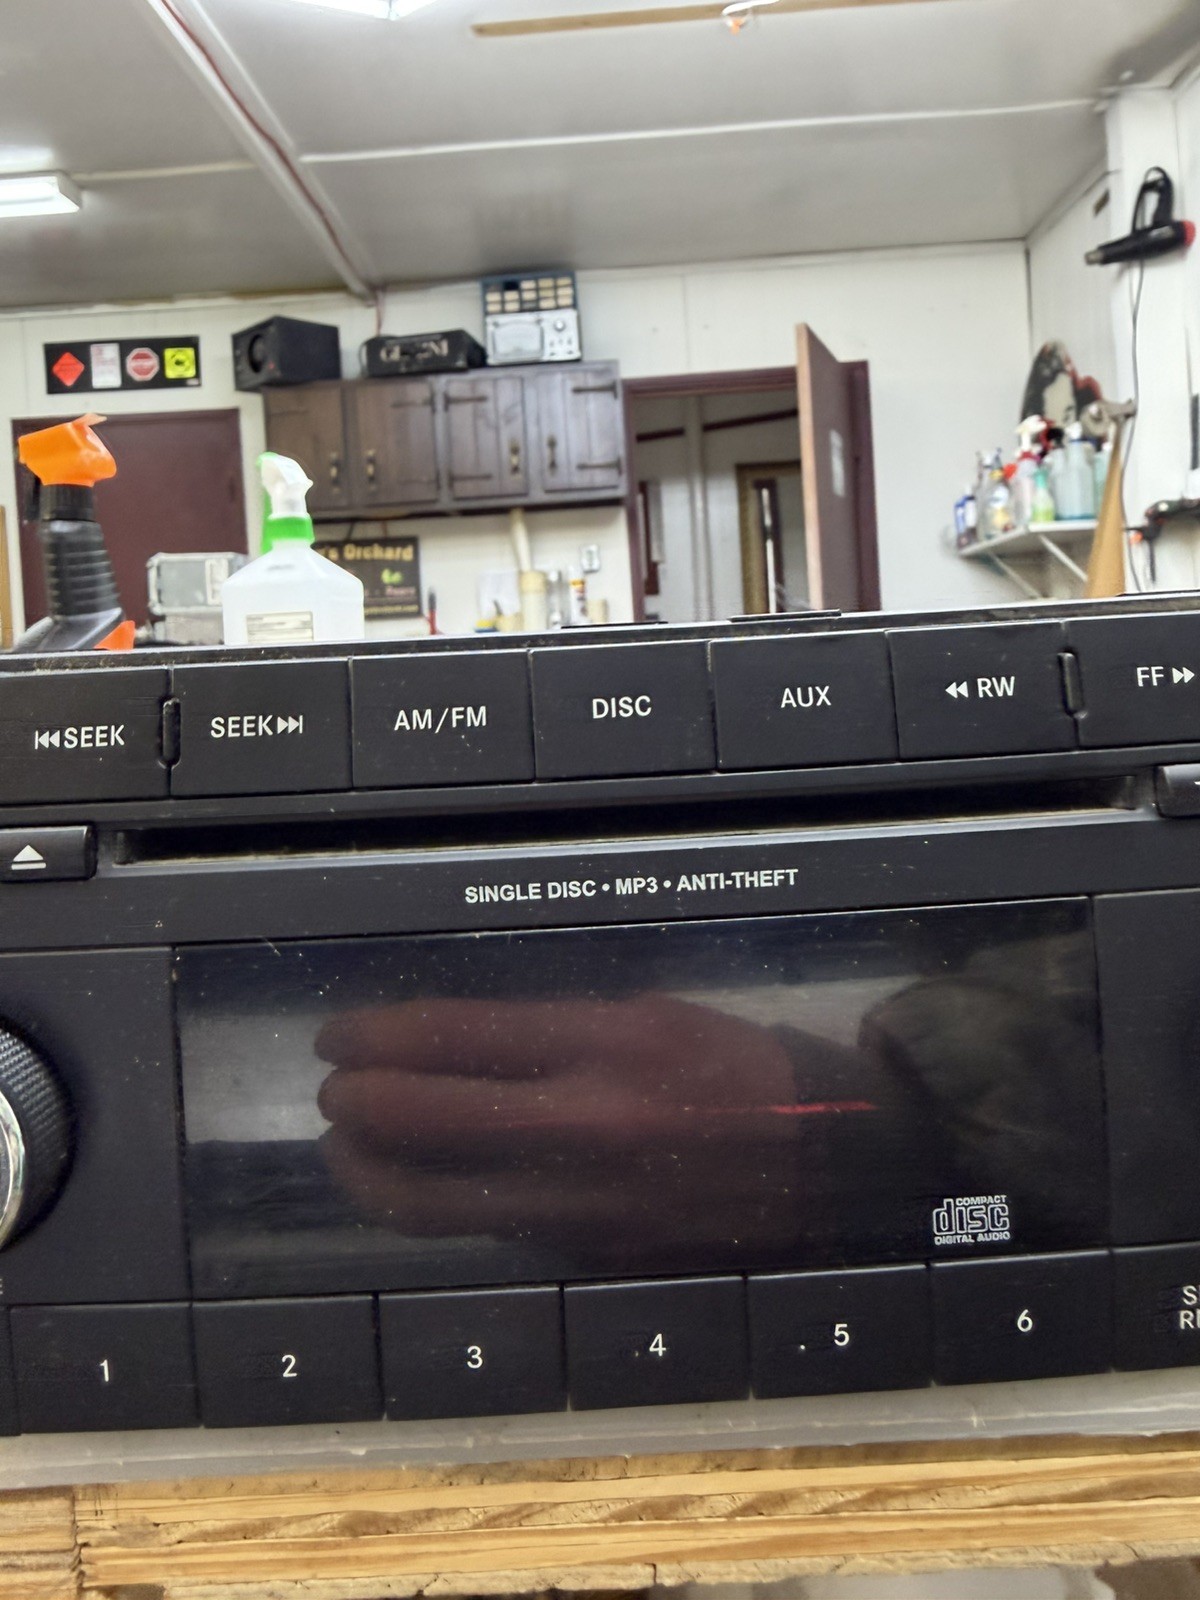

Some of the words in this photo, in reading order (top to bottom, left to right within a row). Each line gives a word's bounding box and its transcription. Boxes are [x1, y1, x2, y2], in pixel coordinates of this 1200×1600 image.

[343, 543, 414, 562] Orchard
[976, 675, 1016, 699] RW
[1136, 665, 1165, 688] FF
[591, 694, 652, 720] DISC
[780, 685, 832, 709] AUX
[210, 714, 274, 739] SEEK
[393, 705, 487, 734] AM/FM
[63, 724, 125, 749] SEEK
[464, 882, 543, 904] SINGLE
[547, 879, 597, 900] DISC
[615, 876, 659, 896] MP3
[676, 868, 799, 893] ANTI-THEFT
[955, 1195, 1007, 1206] COMPACT
[932, 1198, 1010, 1235] disc
[934, 1234, 975, 1245] DIGITAL
[977, 1231, 1011, 1242] AUDIO
[1182, 1285, 1200, 1306] S
[1016, 1308, 1033, 1333] 6
[648, 1333, 667, 1357] 4
[833, 1323, 850, 1347] 5
[281, 1354, 298, 1378] 2
[466, 1345, 484, 1369] 3
[99, 1359, 110, 1383] 1
